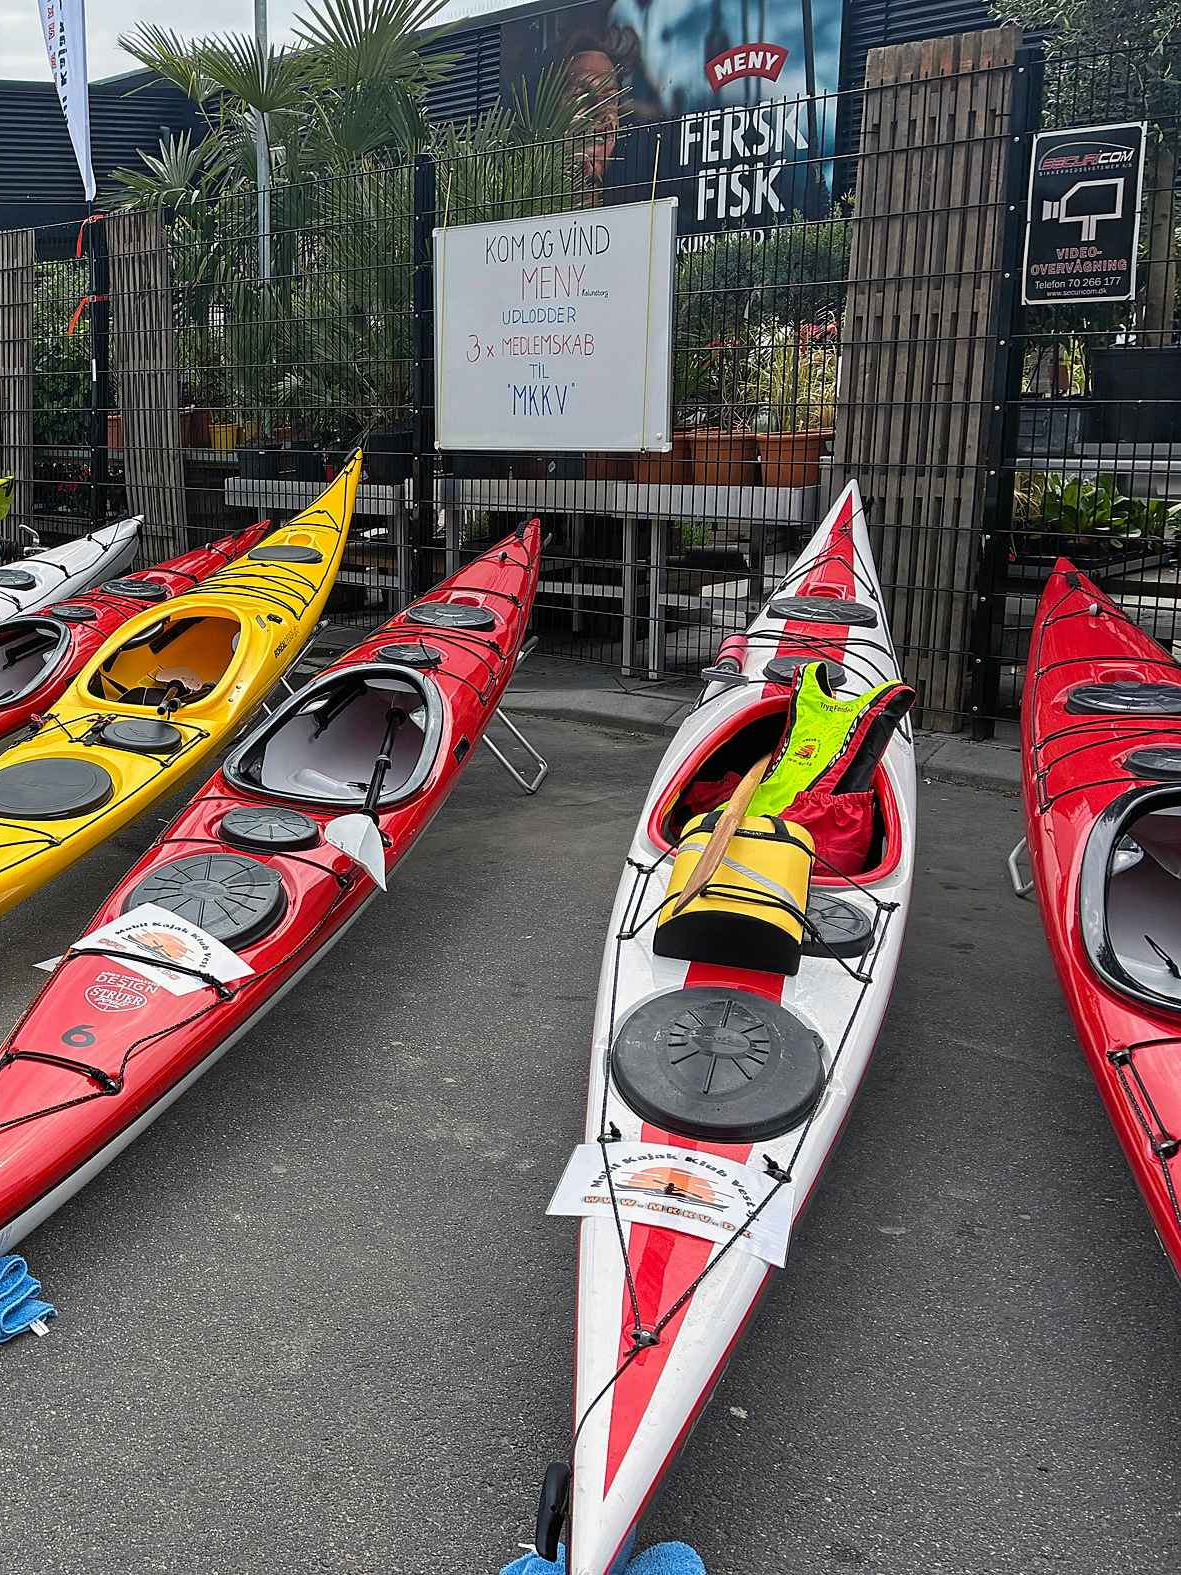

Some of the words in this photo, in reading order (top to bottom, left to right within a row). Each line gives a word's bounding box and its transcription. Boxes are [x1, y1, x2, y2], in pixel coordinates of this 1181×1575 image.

[713, 51, 779, 81] MENY
[679, 95, 811, 166] FERSK
[697, 158, 787, 221] FISK
[485, 234, 525, 264] KOM
[530, 229, 554, 260] OG
[1056, 246, 1103, 260] VIDEO-
[1030, 258, 1128, 276] OVERVÅGNING
[521, 264, 586, 300] MENY
[1035, 280, 1066, 290] Telefon
[1068, 278, 1081, 287] 70
[1082, 277, 1102, 287] 266
[1104, 276, 1122, 286] 177
[1046, 288, 1108, 298] www.securicom.dk
[502, 306, 577, 325] UDLODDER
[466, 334, 481, 363] 3
[502, 333, 596, 356] MEDLEMSKAB
[114, 922, 148, 936] Mobil
[152, 921, 189, 934] Kajak
[190, 933, 209, 953] Klub
[198, 952, 212, 969] Vest
[95, 974, 159, 995] DESIGN
[89, 987, 144, 1006] STRUER
[61, 1024, 96, 1048] 6
[622, 1152, 679, 1165] Kajak
[684, 1156, 728, 1178] Klub
[731, 1179, 757, 1208] Vest
